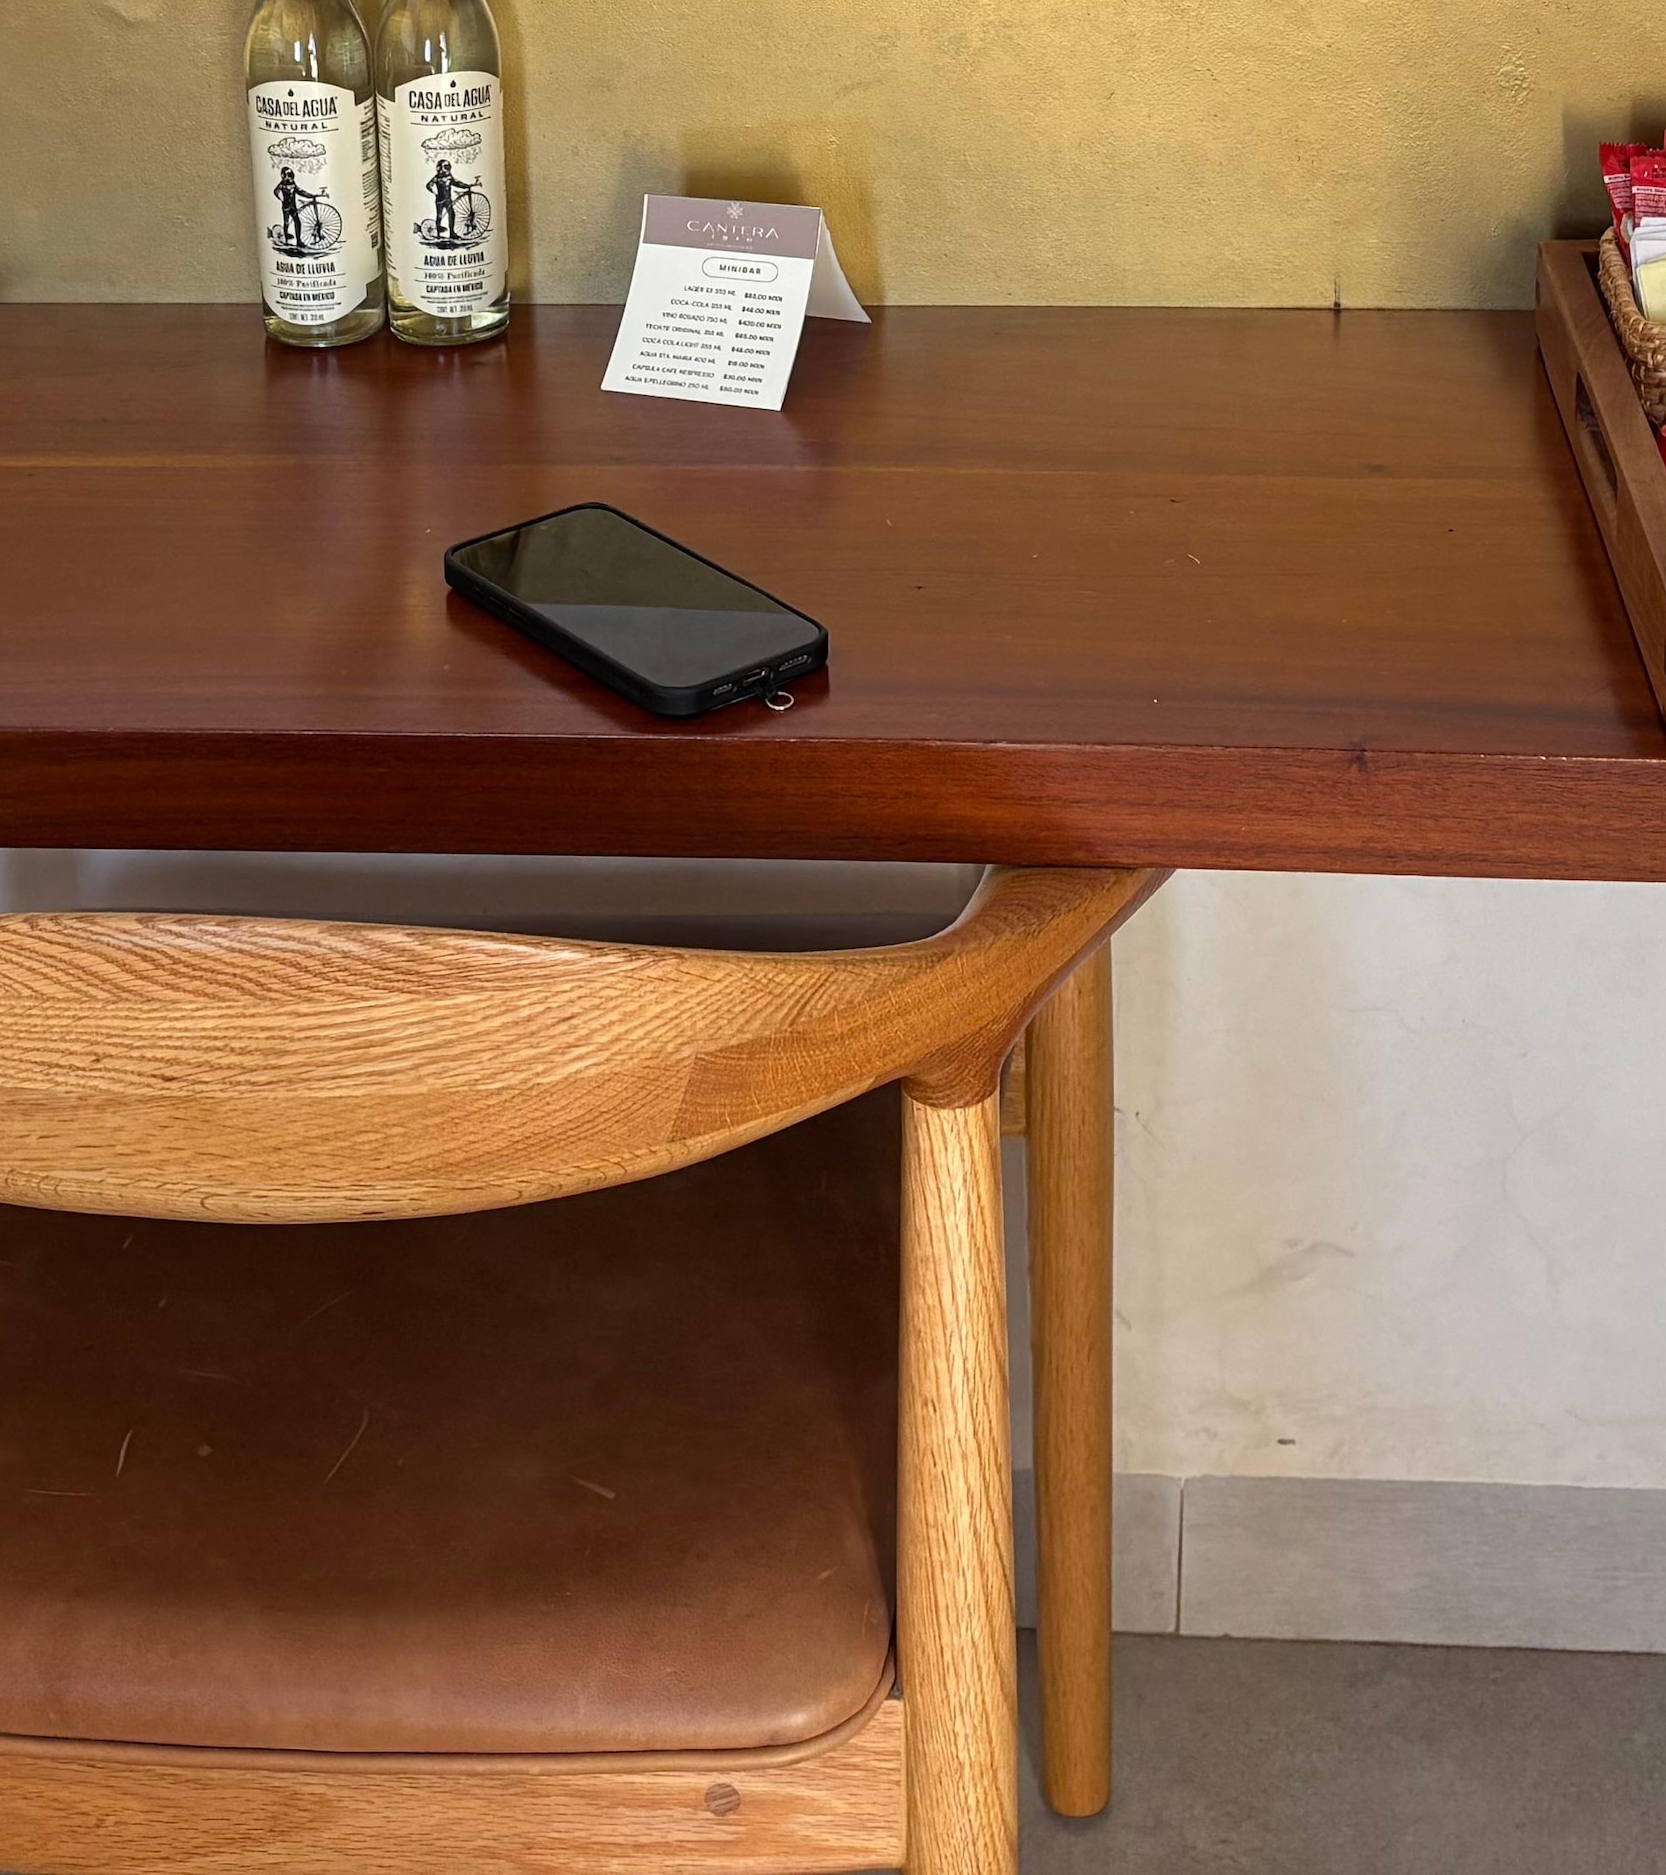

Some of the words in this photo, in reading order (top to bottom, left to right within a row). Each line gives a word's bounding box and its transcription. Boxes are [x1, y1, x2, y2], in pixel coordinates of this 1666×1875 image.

[409, 90, 442, 109] CASA
[444, 93, 460, 107] DEL
[463, 85, 491, 107] AGUA
[256, 95, 282, 117] CASA
[283, 101, 300, 116] DEL
[302, 97, 337, 117] AGUA
[421, 111, 483, 122] NATURAL
[265, 121, 328, 131] NATURAL
[686, 220, 779, 239] CANTERA
[447, 256, 457, 266] DE
[459, 251, 484, 264] LLUVIA
[296, 263, 305, 274] DE
[308, 262, 335, 275] LLUVIA
[719, 264, 761, 275] MINIBAR
